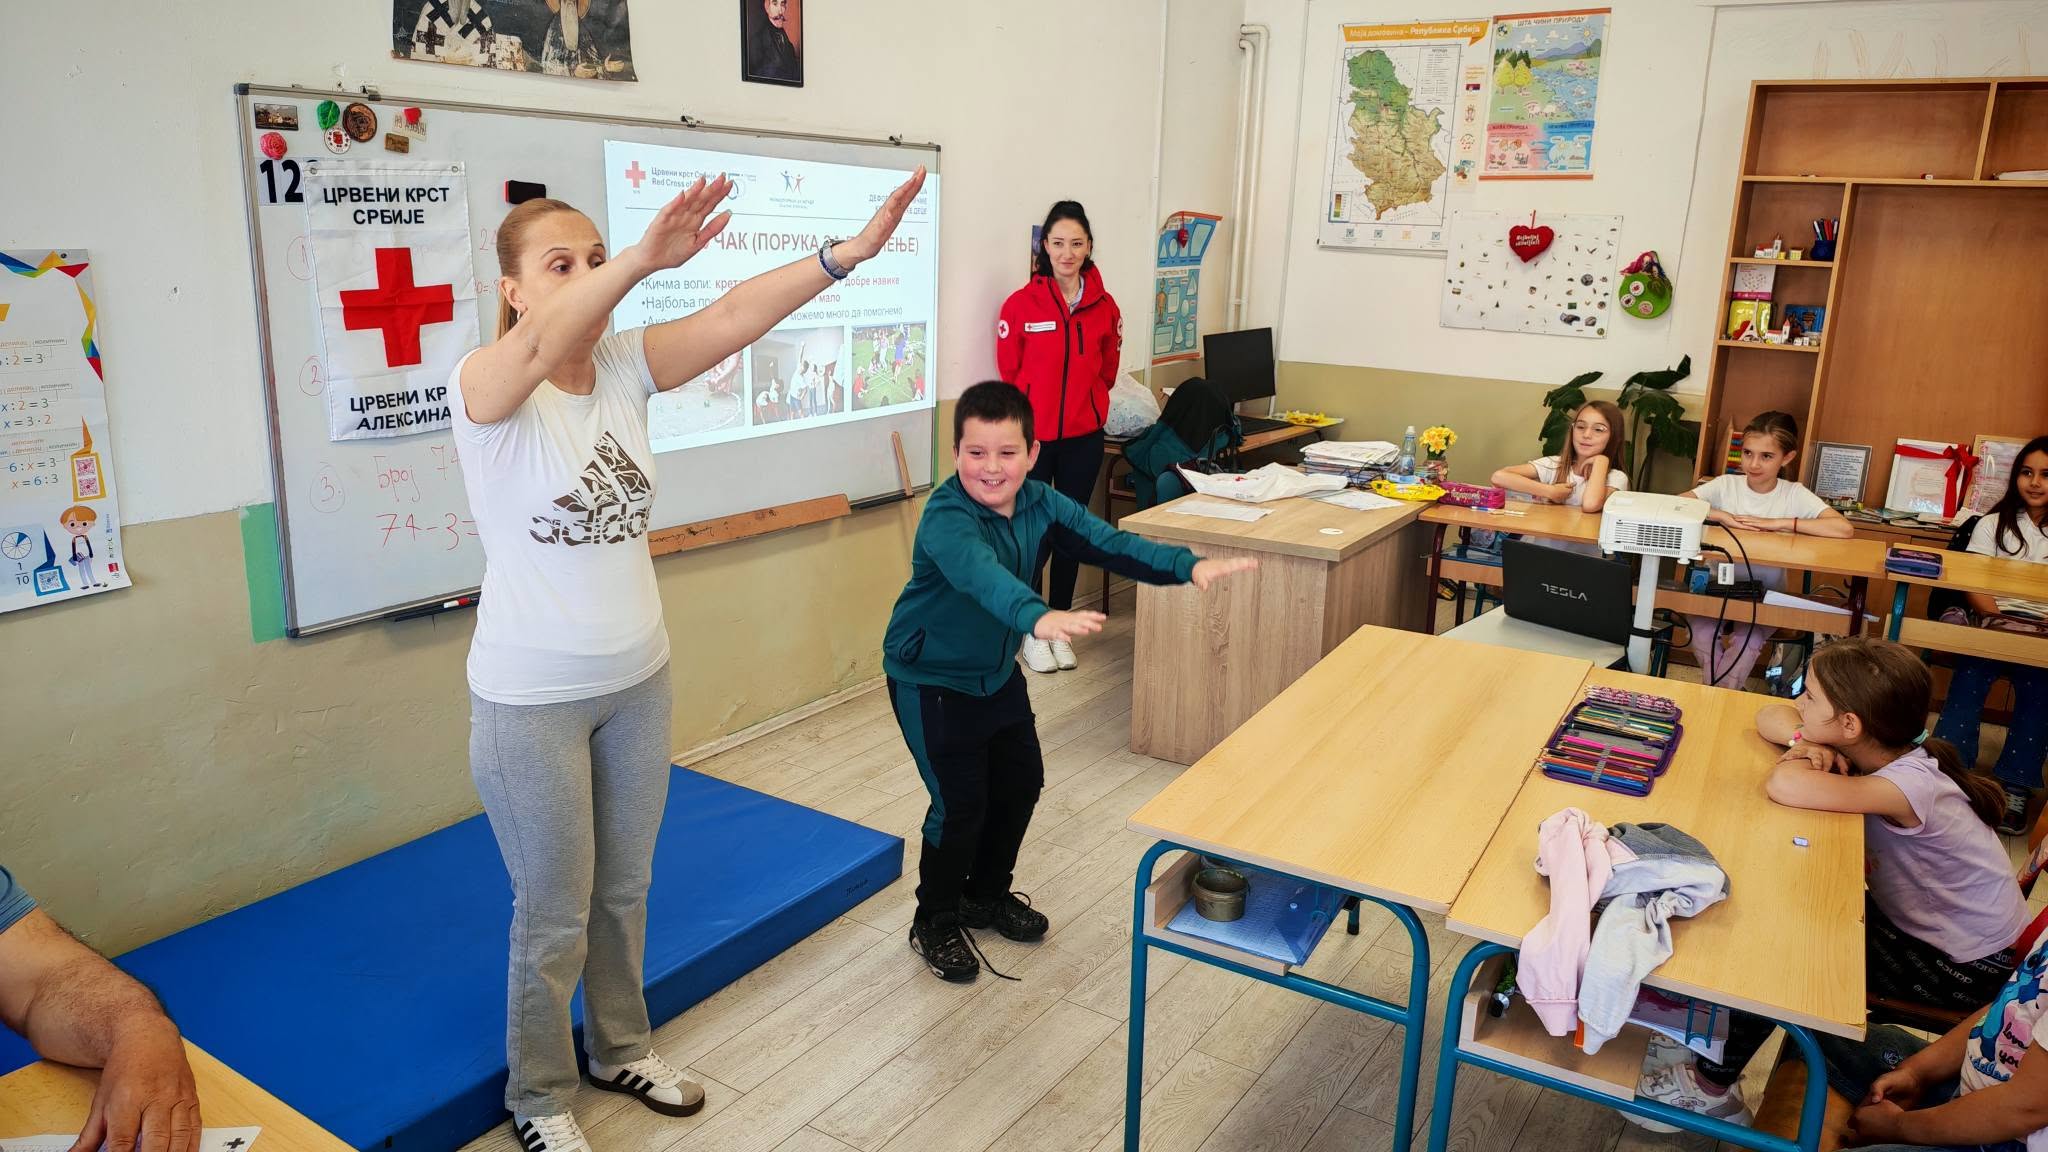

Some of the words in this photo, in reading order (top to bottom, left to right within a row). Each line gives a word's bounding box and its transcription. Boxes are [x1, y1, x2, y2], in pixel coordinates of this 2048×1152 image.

[260, 159, 304, 203] 12
[323, 187, 400, 206] ЦРВЕНИ
[405, 187, 450, 202] КРСТ
[353, 209, 424, 224] СРБИЈЕ
[752, 232, 818, 255] (ПОРУКА
[645, 277, 681, 291] Кичма
[684, 279, 711, 289] воли:
[845, 275, 870, 288] добре
[646, 296, 696, 312] Најбоља
[819, 293, 841, 303] мало
[350, 390, 419, 414] ЦРВЕНИ
[425, 387, 447, 402] КР
[356, 406, 452, 430] АЛЕКСИНА
[528, 502, 652, 546] adida
[1541, 583, 1588, 602] TESLA
